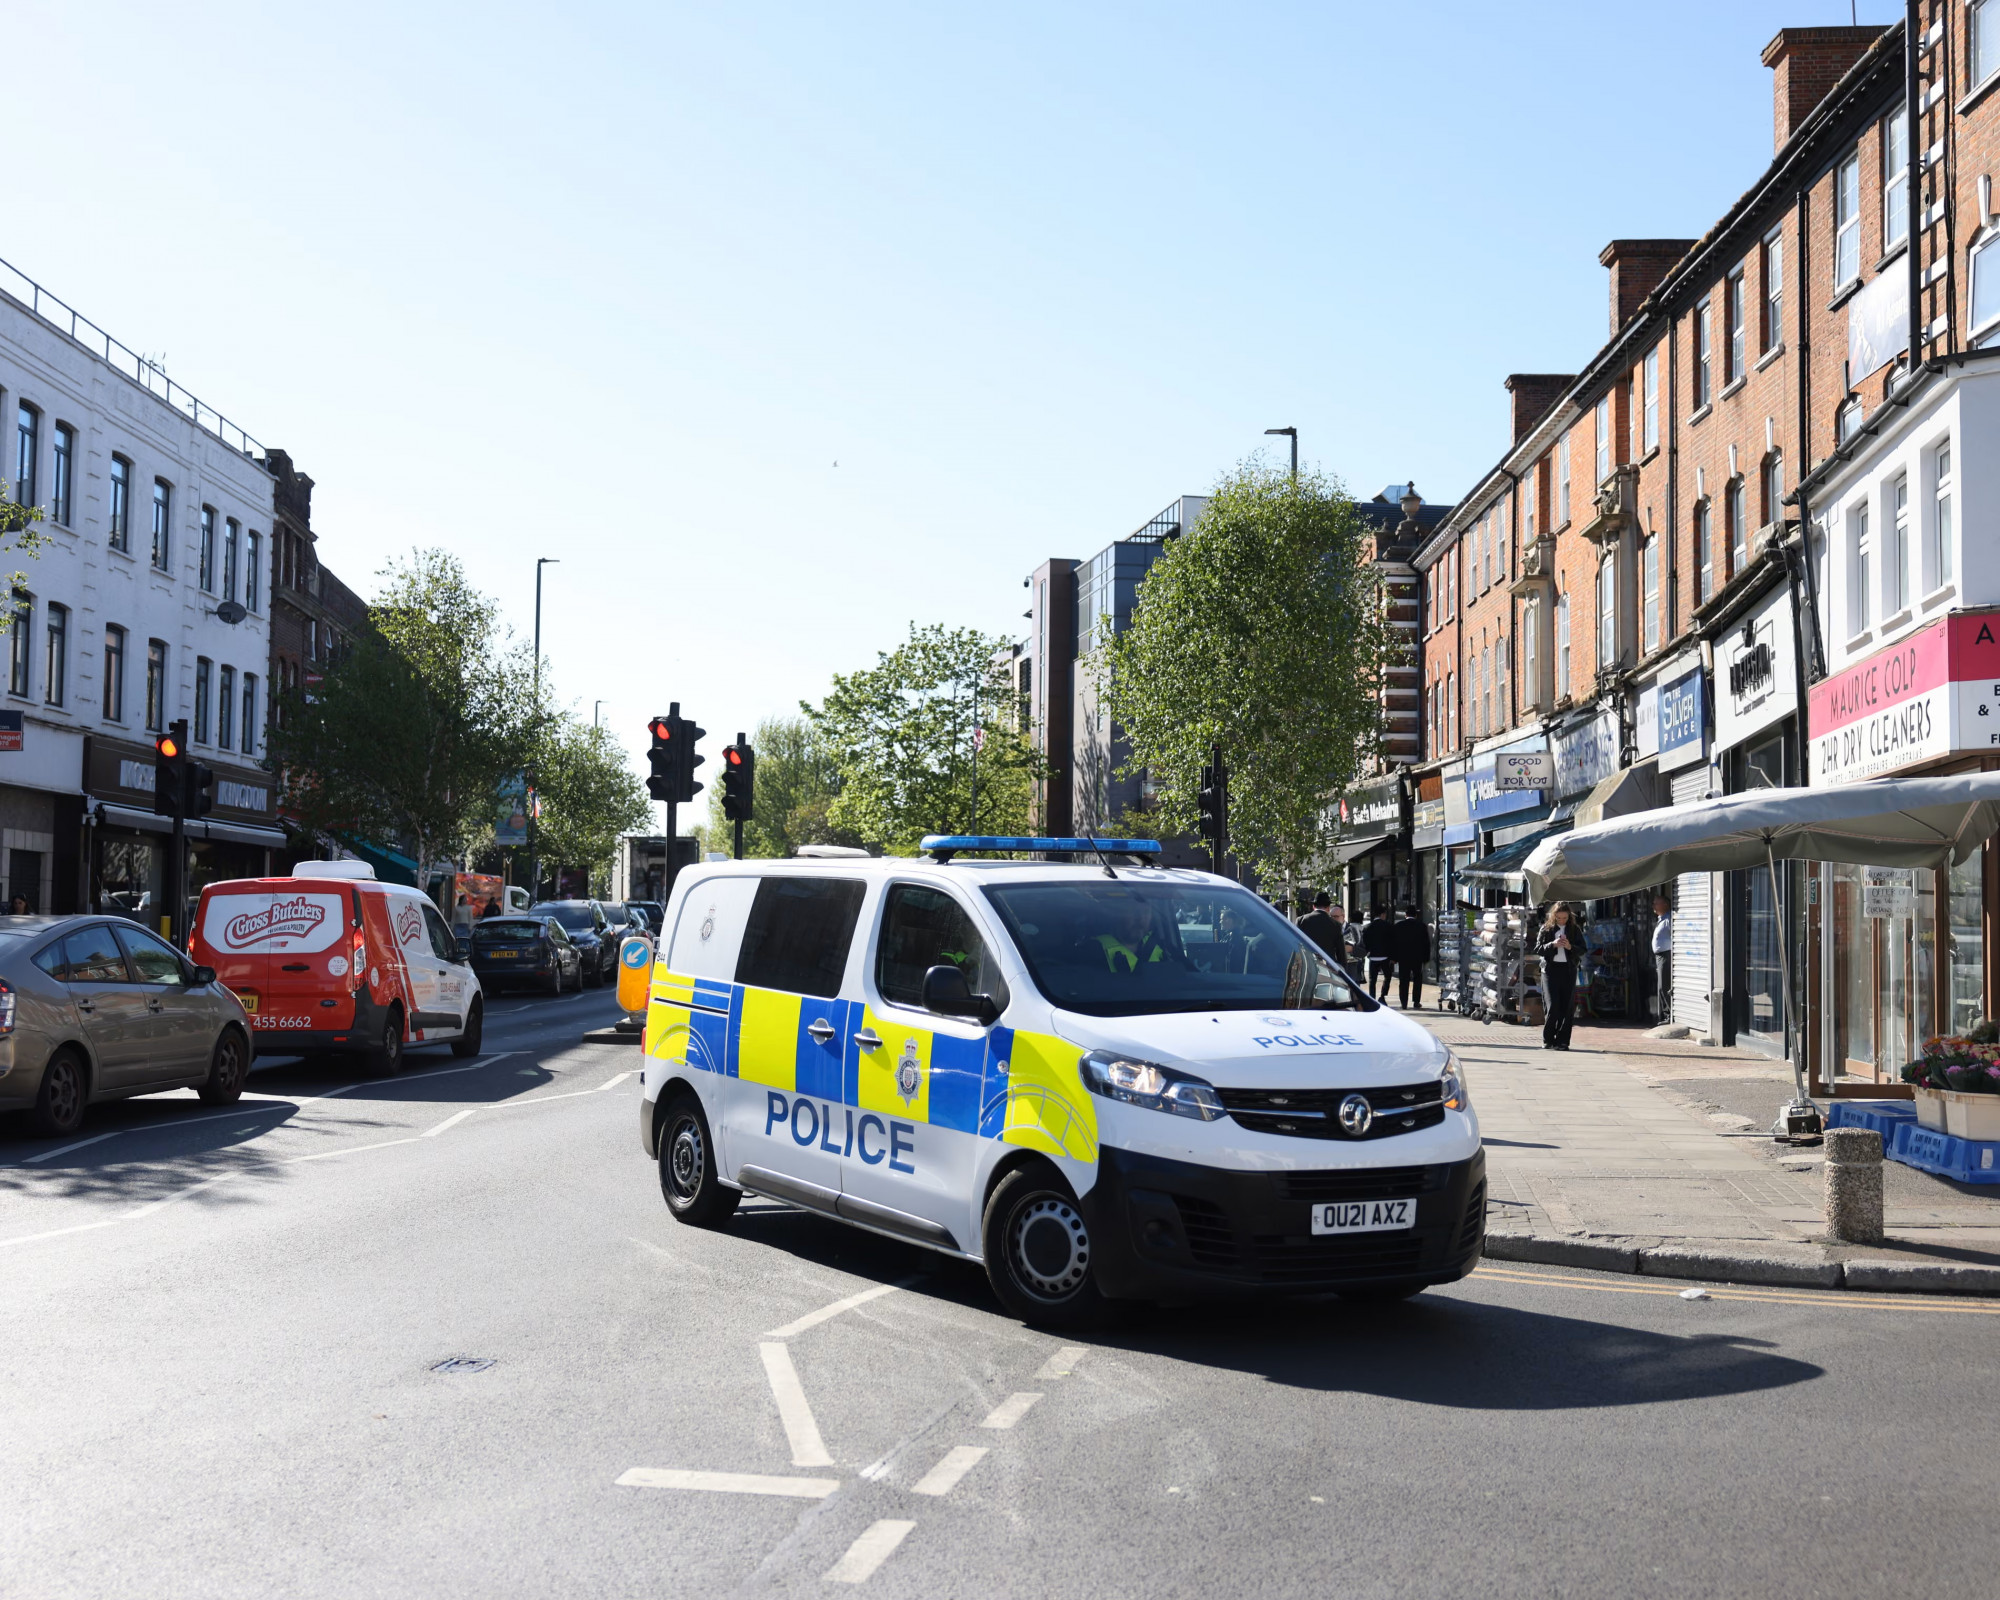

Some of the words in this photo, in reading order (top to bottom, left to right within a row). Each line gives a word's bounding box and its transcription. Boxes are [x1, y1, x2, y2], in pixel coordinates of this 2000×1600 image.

[1671, 687, 1681, 700] THE
[1830, 666, 1877, 723] MAURICE
[1884, 648, 1916, 698] COLP
[1663, 691, 1694, 730] SILVER
[1978, 704, 1989, 716] &
[1663, 721, 1695, 744] PLACE
[1821, 736, 1838, 774] 2HR
[1844, 724, 1863, 767] DRY
[1869, 698, 1931, 757] CLEANERS
[1508, 758, 1542, 766] GOOD
[1503, 777, 1524, 786] FOR
[1525, 776, 1548, 787] YOU
[1370, 797, 1399, 822] Mehadrin
[233, 910, 269, 937] Gross
[271, 898, 322, 924] Butchers
[253, 1016, 276, 1028] 455
[279, 1016, 312, 1028] 6662
[1252, 1034, 1364, 1048] POLICE
[765, 1091, 915, 1174] POLICE
[1324, 1204, 1366, 1228] OU21
[1371, 1202, 1408, 1225] AXZ
